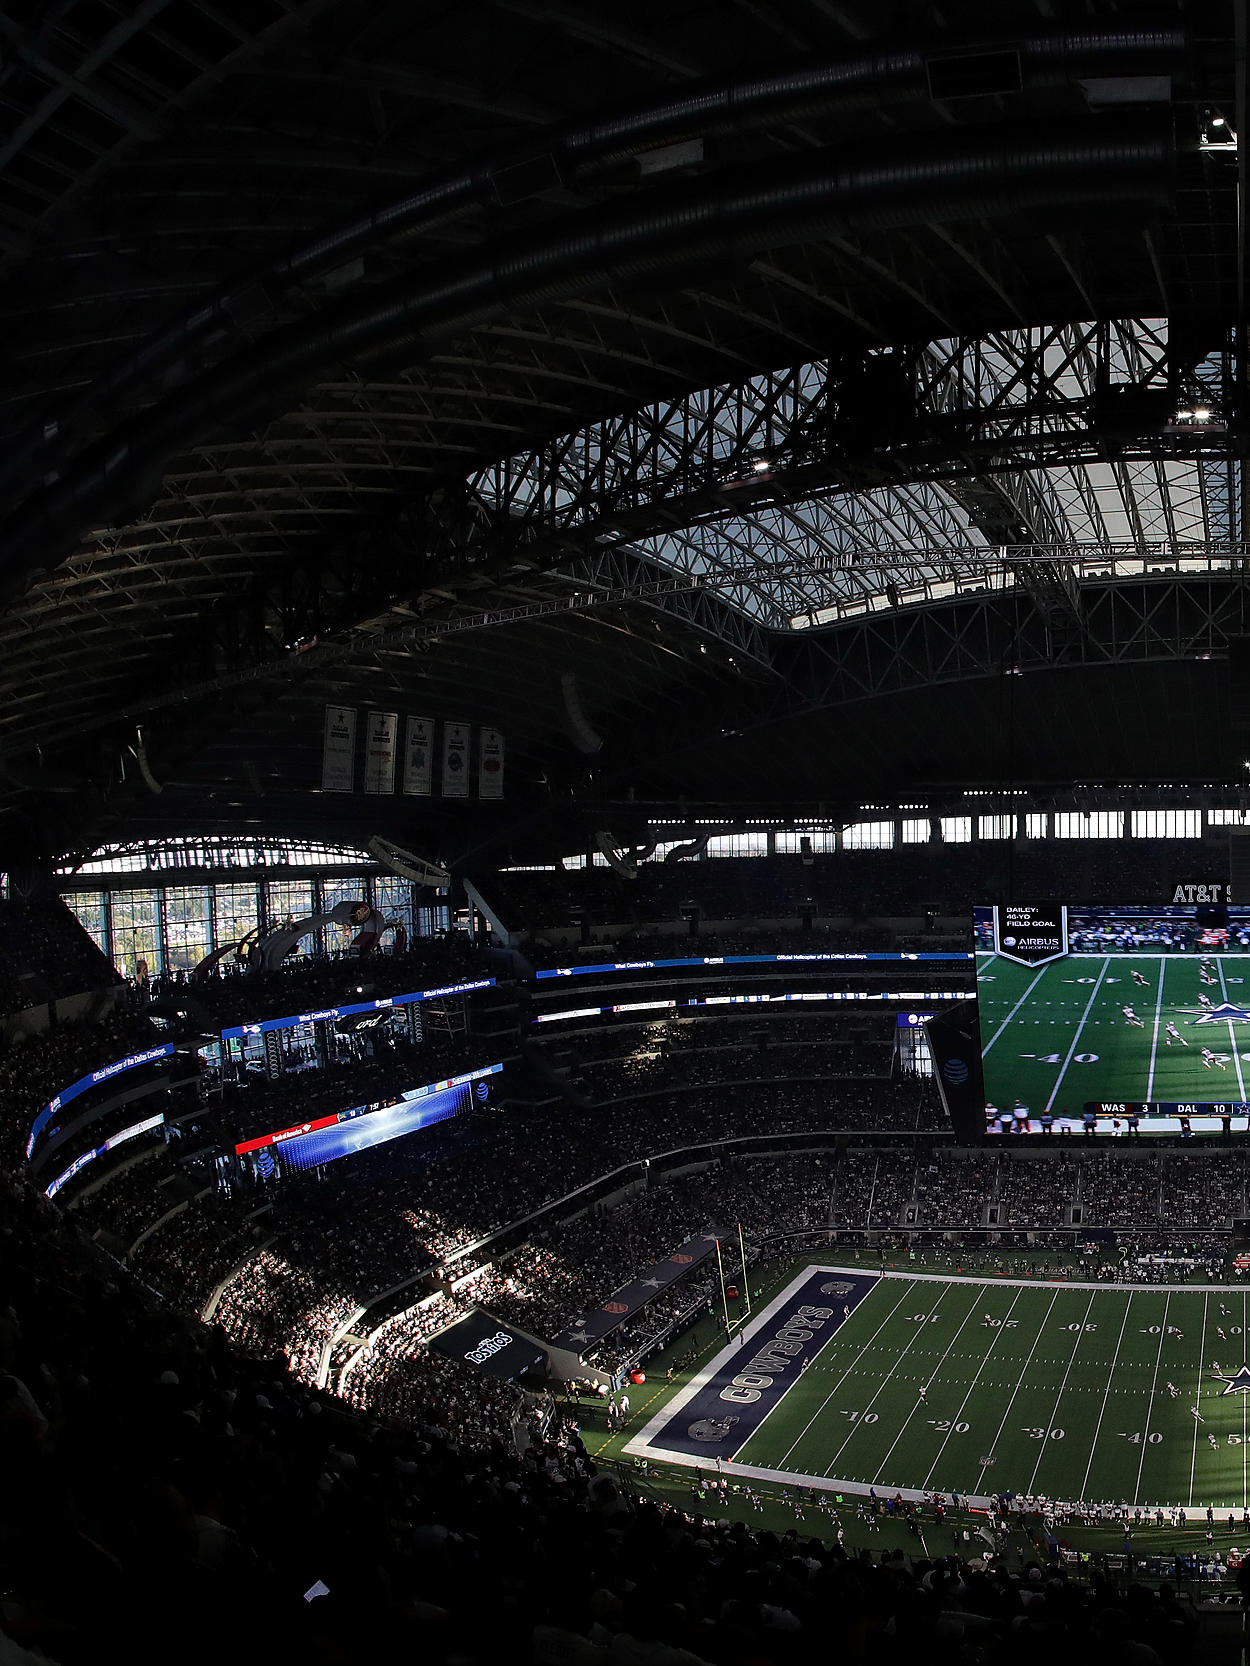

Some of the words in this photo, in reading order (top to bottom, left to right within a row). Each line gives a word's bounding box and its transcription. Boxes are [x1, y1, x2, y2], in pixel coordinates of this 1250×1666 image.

[1172, 884, 1222, 902] AT&T
[1101, 1103, 1126, 1112] WAS
[1142, 1104, 1149, 1112] 3
[1177, 1104, 1198, 1113] DAL
[1213, 1104, 1226, 1113] 10
[464, 1332, 513, 1365] Tostitos
[719, 1305, 834, 1404] COWBOYS
[847, 1410, 880, 1425] 10
[934, 1419, 971, 1434] 20
[1029, 1427, 1066, 1441] 30
[1127, 1432, 1164, 1445] 40
